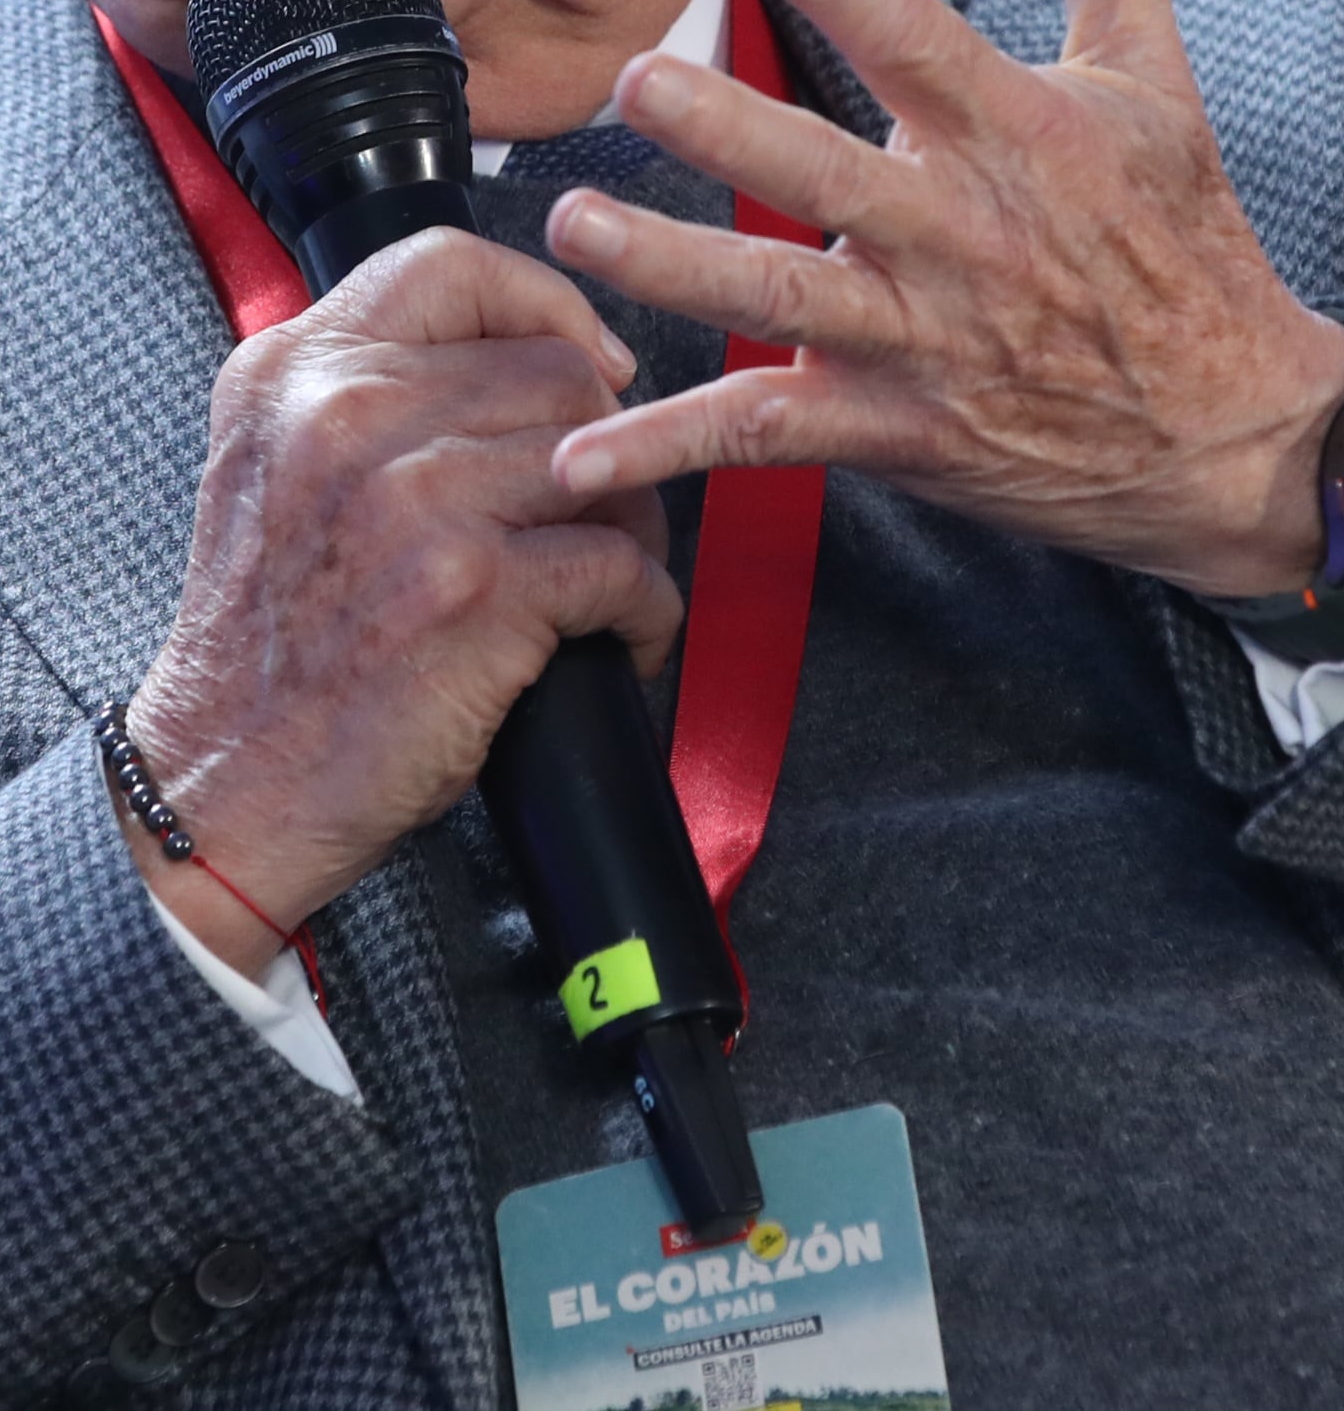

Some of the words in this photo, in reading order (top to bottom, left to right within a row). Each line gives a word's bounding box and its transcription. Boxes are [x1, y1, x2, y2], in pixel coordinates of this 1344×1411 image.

[223, 44, 315, 105] beyerdynamic
[581, 965, 608, 1011] 2
[549, 1282, 611, 1329] EL
[617, 1222, 883, 1312] CORAZÓN
[663, 1306, 712, 1334] DEL
[715, 1291, 776, 1322] PAÍS
[637, 1337, 724, 1368] CONSULTE
[725, 1332, 747, 1350] LA
[749, 1319, 818, 1346] AGENDA
